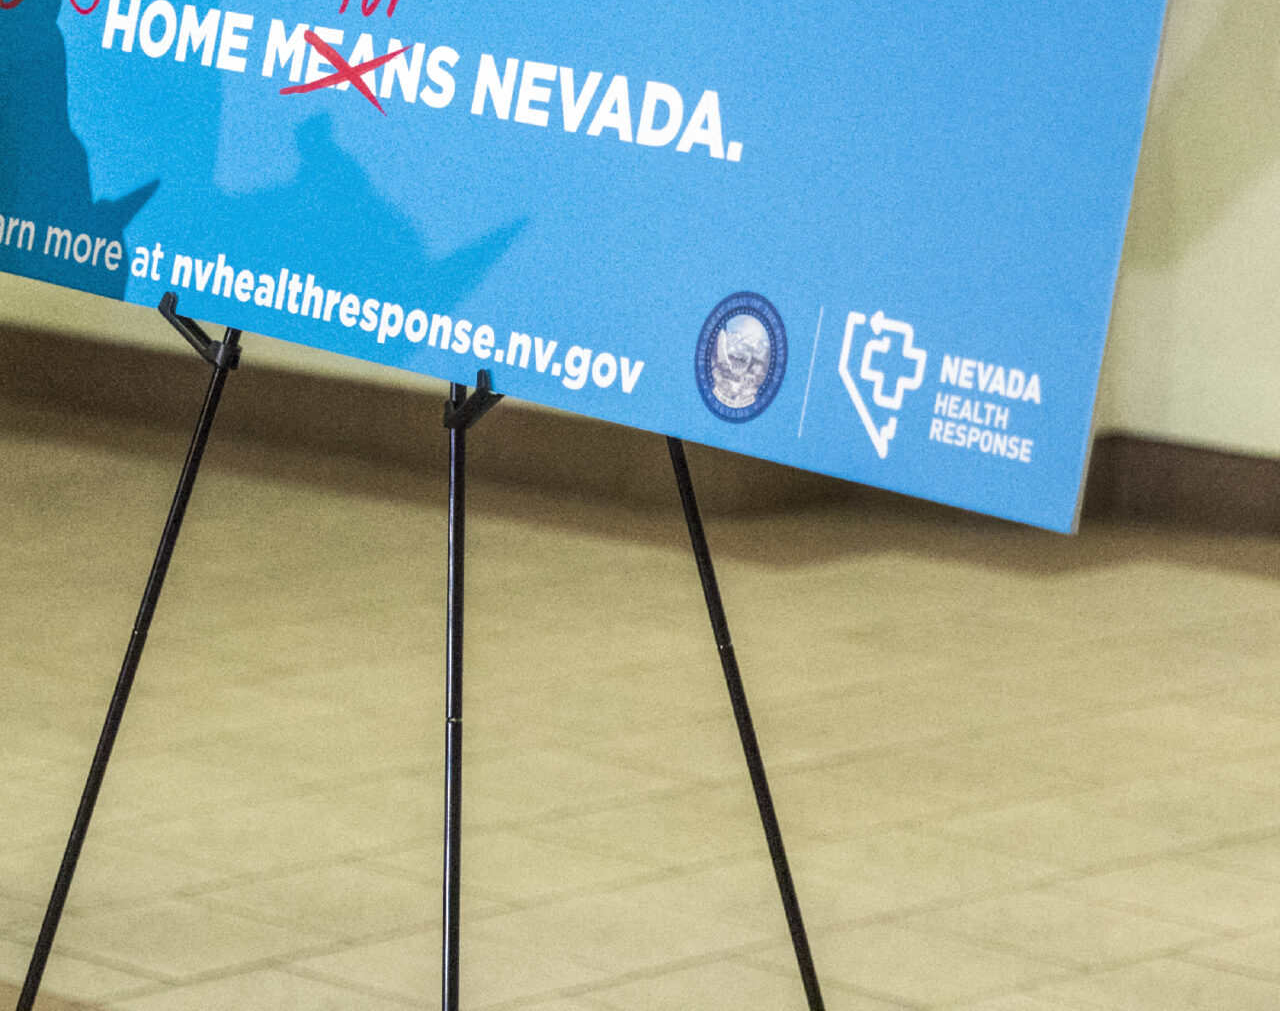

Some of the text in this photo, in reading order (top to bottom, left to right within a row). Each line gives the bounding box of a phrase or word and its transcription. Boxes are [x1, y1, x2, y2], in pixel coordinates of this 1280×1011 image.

[261, 18, 461, 109] MEANS
[470, 52, 744, 163] NEVADA.
[43, 224, 123, 272] more
[130, 241, 165, 282] at
[170, 252, 646, 395] nvhealthresponse.nv.gov
[940, 353, 1042, 405] NEVADA
[933, 391, 1010, 430] HEALTH
[929, 417, 1035, 463] RESPONSE
